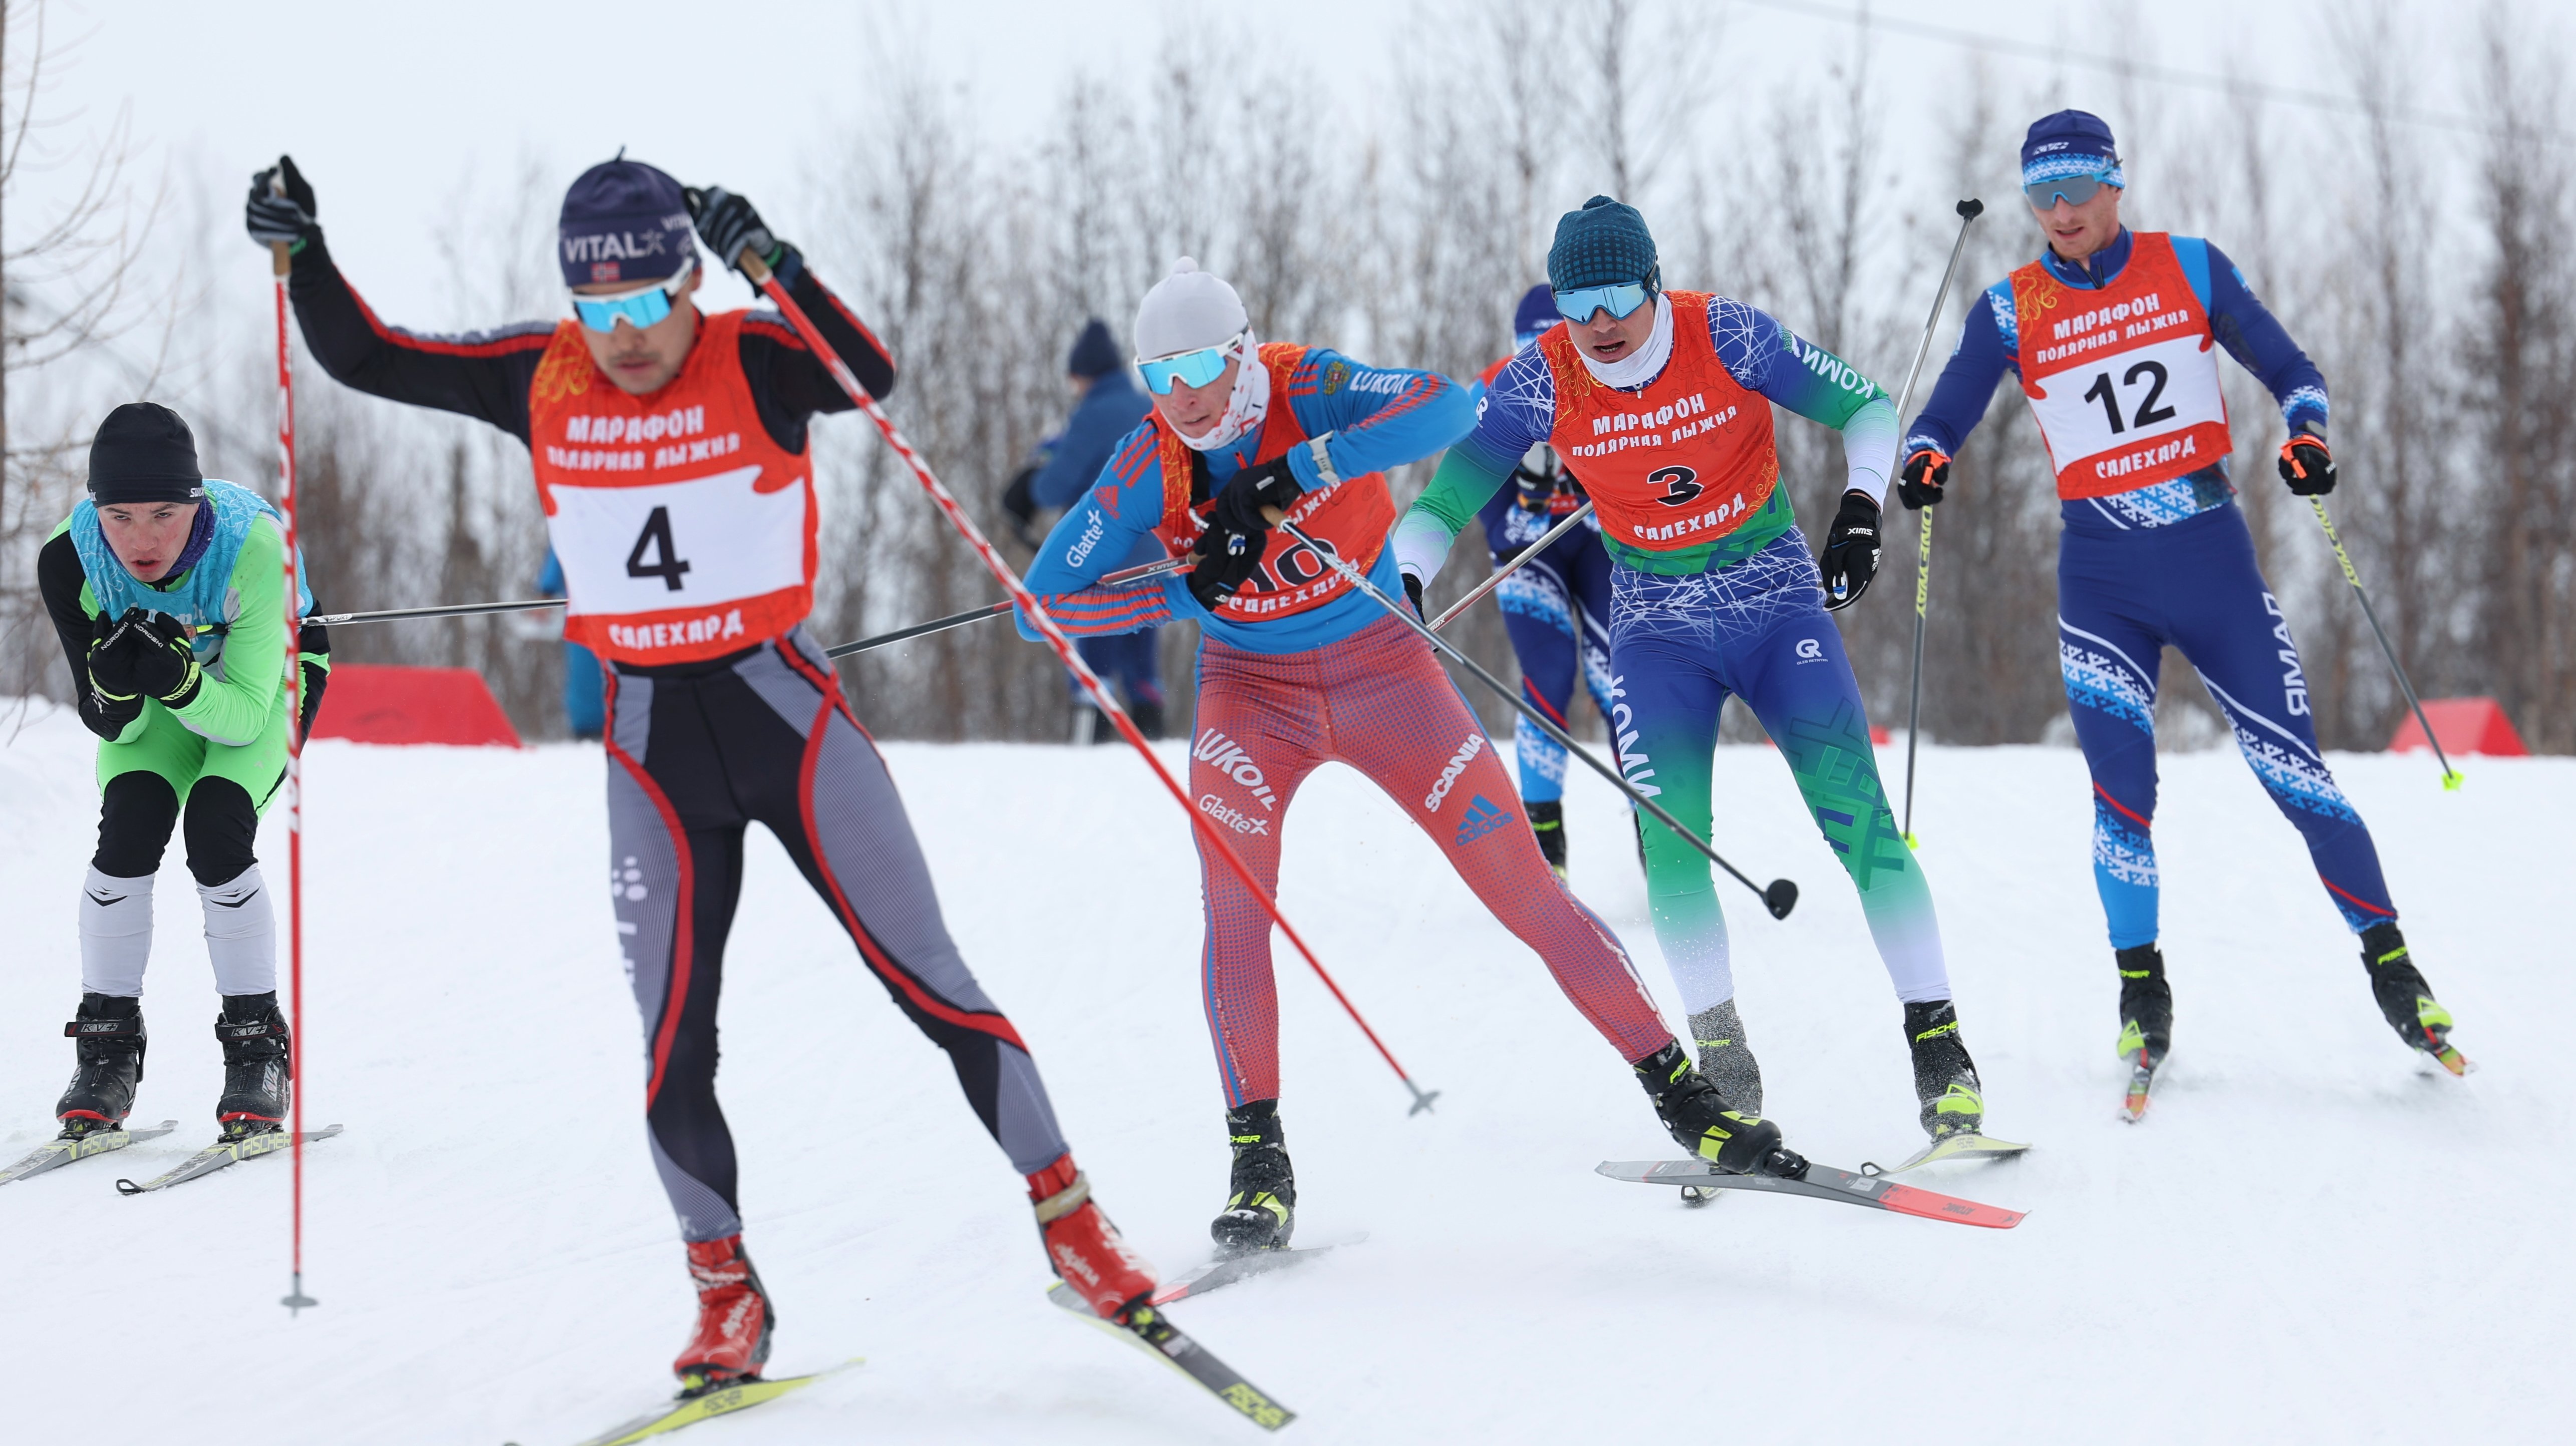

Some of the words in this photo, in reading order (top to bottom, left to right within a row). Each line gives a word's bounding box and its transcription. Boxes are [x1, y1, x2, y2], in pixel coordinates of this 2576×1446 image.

[2037, 329, 2118, 364] ПОЛЯРНАЯ
[2125, 310, 2189, 339] ЛЫЖНЯ
[2053, 293, 2160, 340] МАРАФОН
[1803, 343, 1875, 399] КОМИ
[1592, 393, 1706, 436] МАРАФОН
[2084, 361, 2176, 435] 12
[566, 405, 704, 444] МАРАФОН
[1572, 434, 1662, 457] ПОЛЯРНАЯ
[1671, 405, 1737, 444] ЛЫЖНЯ
[546, 445, 646, 472] ПОЛЯРНАЯ
[654, 433, 740, 470] ЛЫЖНЯ
[2095, 434, 2196, 479] САЛЕХАРД
[1646, 465, 1705, 507] 3
[1633, 492, 1746, 541] САЛЕХАРД
[626, 506, 691, 591] 4
[100, 622, 129, 651] NORDSKI
[133, 623, 164, 648] NORDSKI
[608, 609, 745, 651] САЛЕХАРД
[2261, 591, 2311, 717] ЯМАЛ
[1193, 727, 1277, 811] LUKOIL
[1424, 733, 1485, 813] SCANIA
[1455, 811, 1515, 846] adidas
[81, 1131, 129, 1157] FISCHER
[242, 1132, 292, 1158] FISCHER
